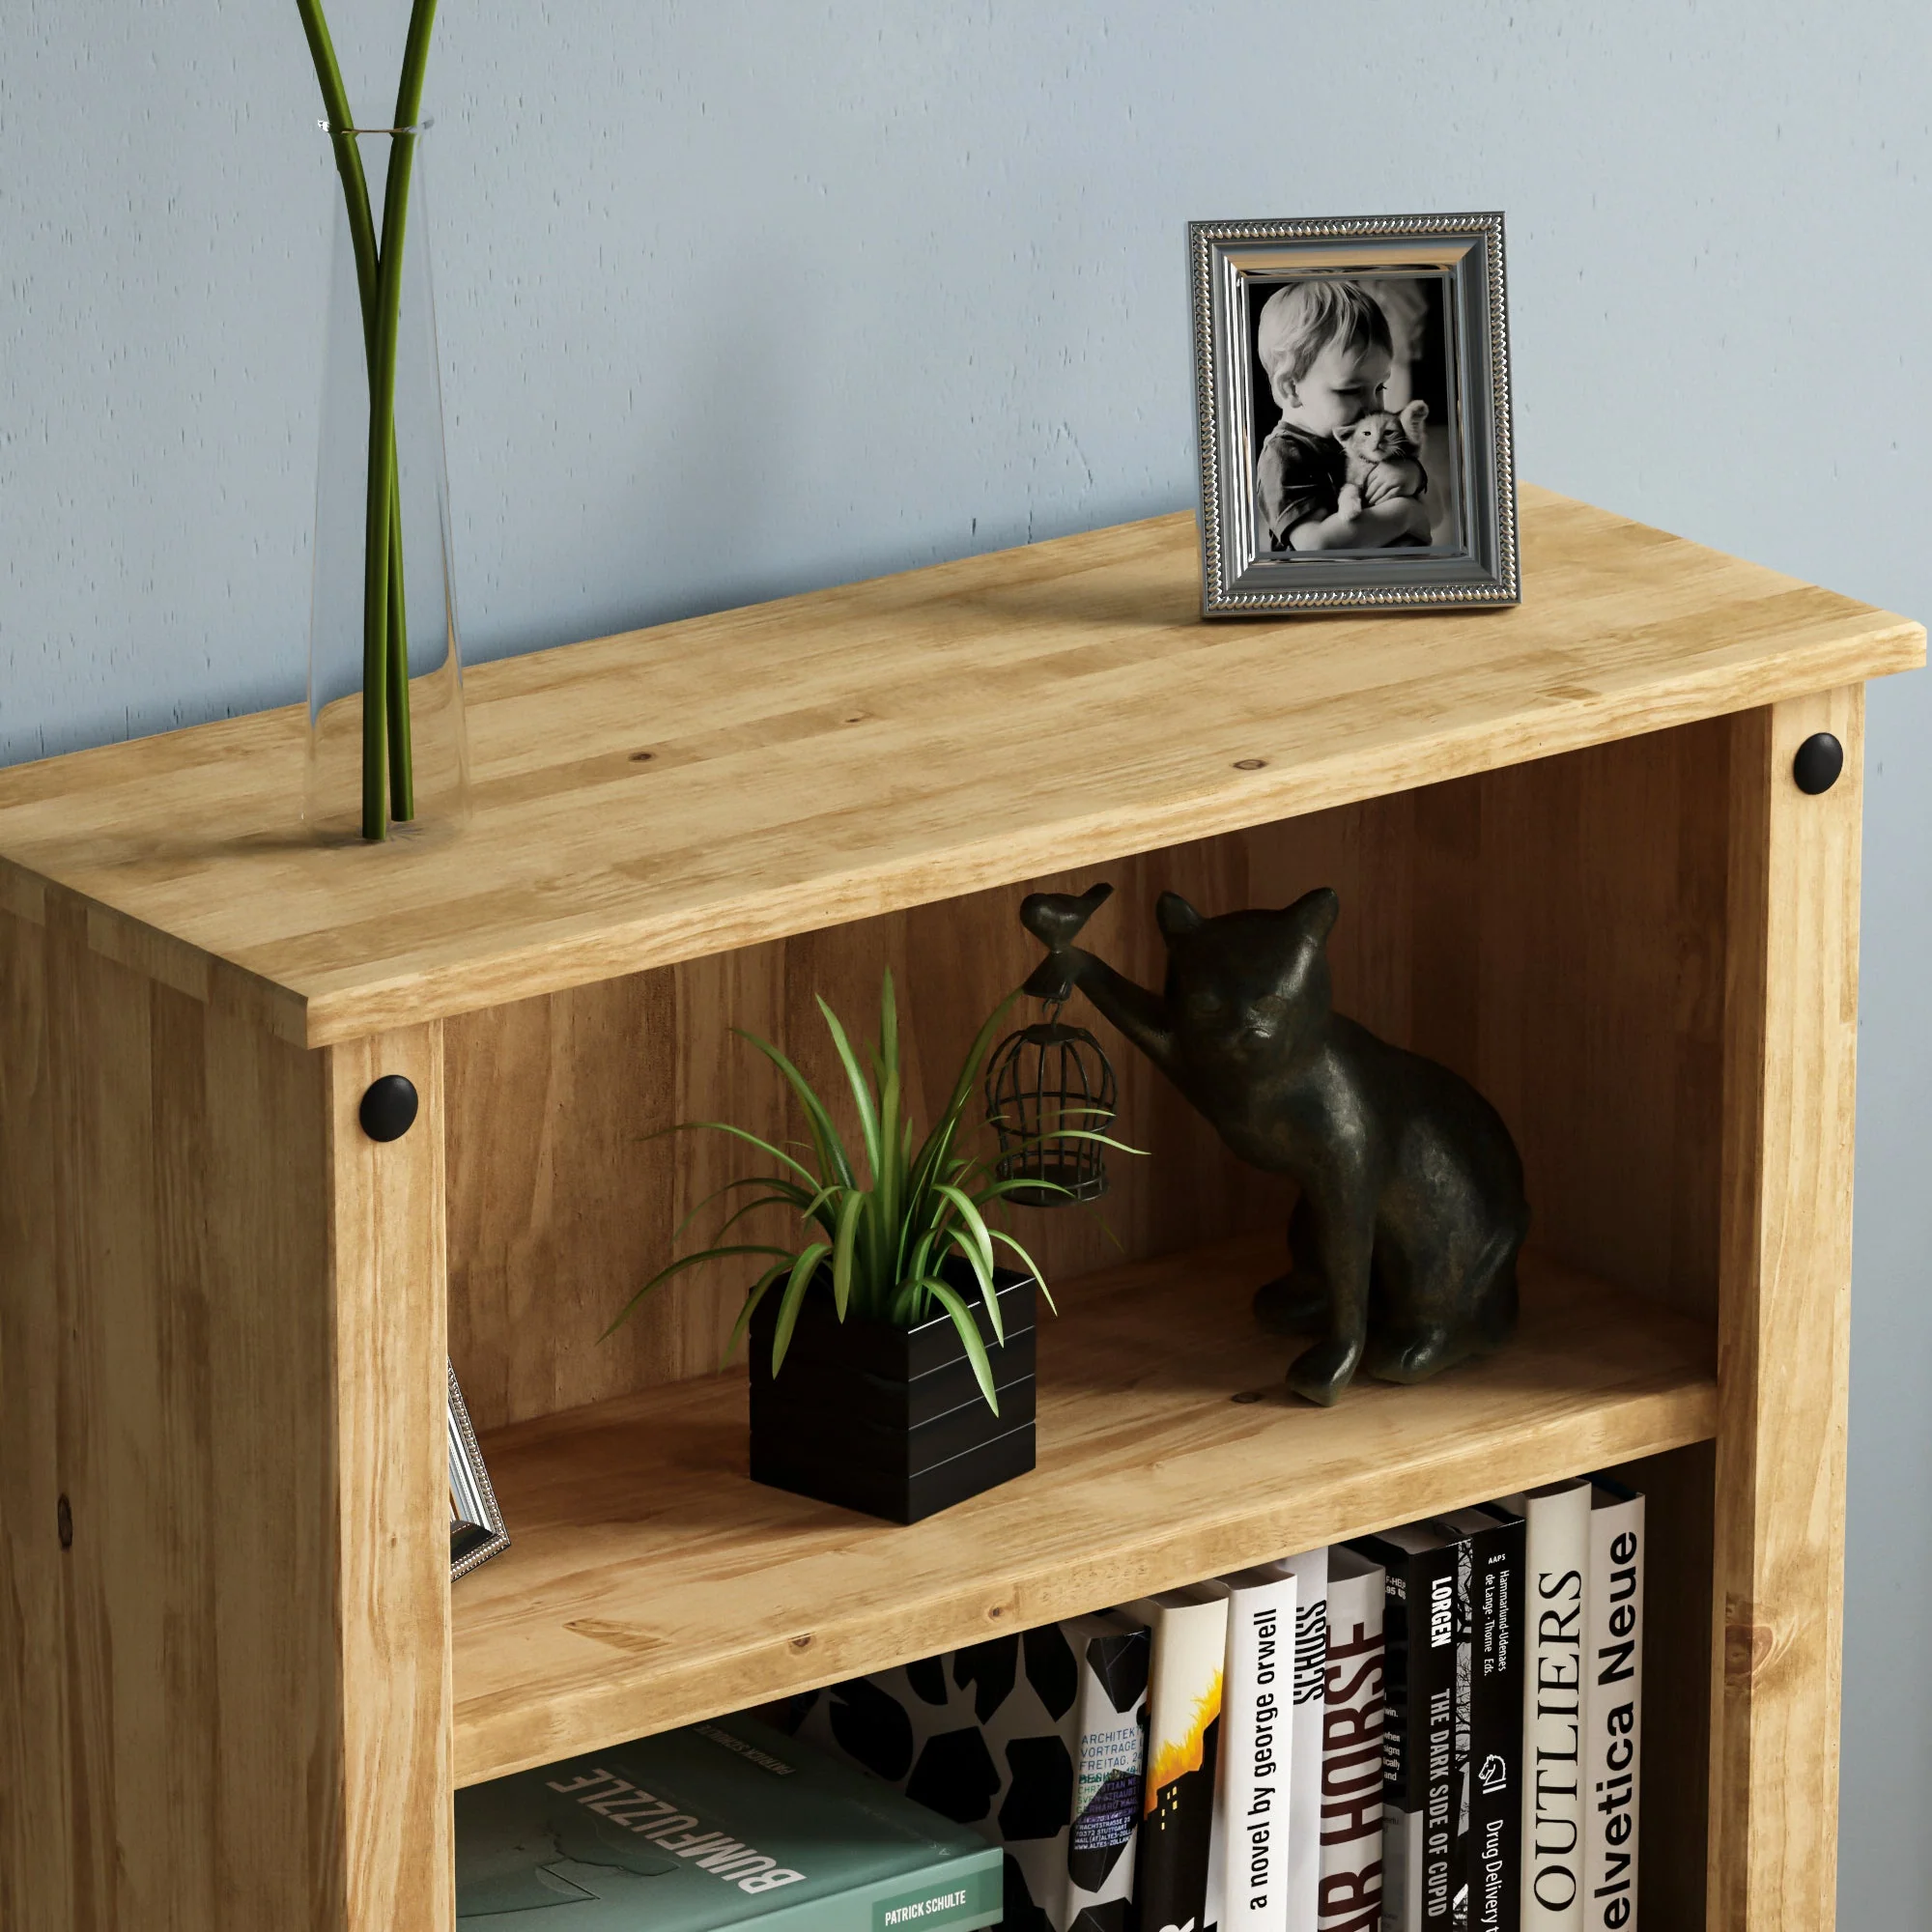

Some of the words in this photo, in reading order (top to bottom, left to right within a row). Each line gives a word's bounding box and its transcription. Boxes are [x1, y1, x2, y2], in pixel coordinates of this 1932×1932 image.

[1485, 1574, 1495, 1585] de
[1488, 1553, 1506, 1565] AAPS
[1432, 1577, 1453, 1648] LORGEN
[1483, 1586, 1495, 1615] Lange
[1498, 1570, 1510, 1672] Hammarlund-Udenaes
[1598, 1531, 1637, 1686] Neue
[1253, 1608, 1277, 1685] orwell
[1484, 1619, 1495, 1653] Thorne
[1484, 1659, 1494, 1677] Eds.
[1320, 1611, 1385, 1846] HORSE
[1431, 1688, 1451, 1726] THE
[1254, 1692, 1278, 1777] george
[1430, 1729, 1451, 1781] DARK
[1534, 1570, 1582, 1912] OUTLIERS
[1247, 1787, 1276, 1815] by
[1429, 1784, 1449, 1829] SIDE
[1594, 1701, 1634, 1932] elvetica
[546, 1768, 807, 1893] BUMFUZZLE
[1247, 1822, 1270, 1888] novel
[1428, 1833, 1449, 1855] OF
[1481, 1819, 1504, 1860] Drug
[885, 1902, 924, 1926] PATRICK
[925, 1889, 966, 1915] SCHULTE
[1250, 1895, 1268, 1911] a
[1428, 1861, 1448, 1918] CUPID
[1480, 1861, 1503, 1923] Delivery
